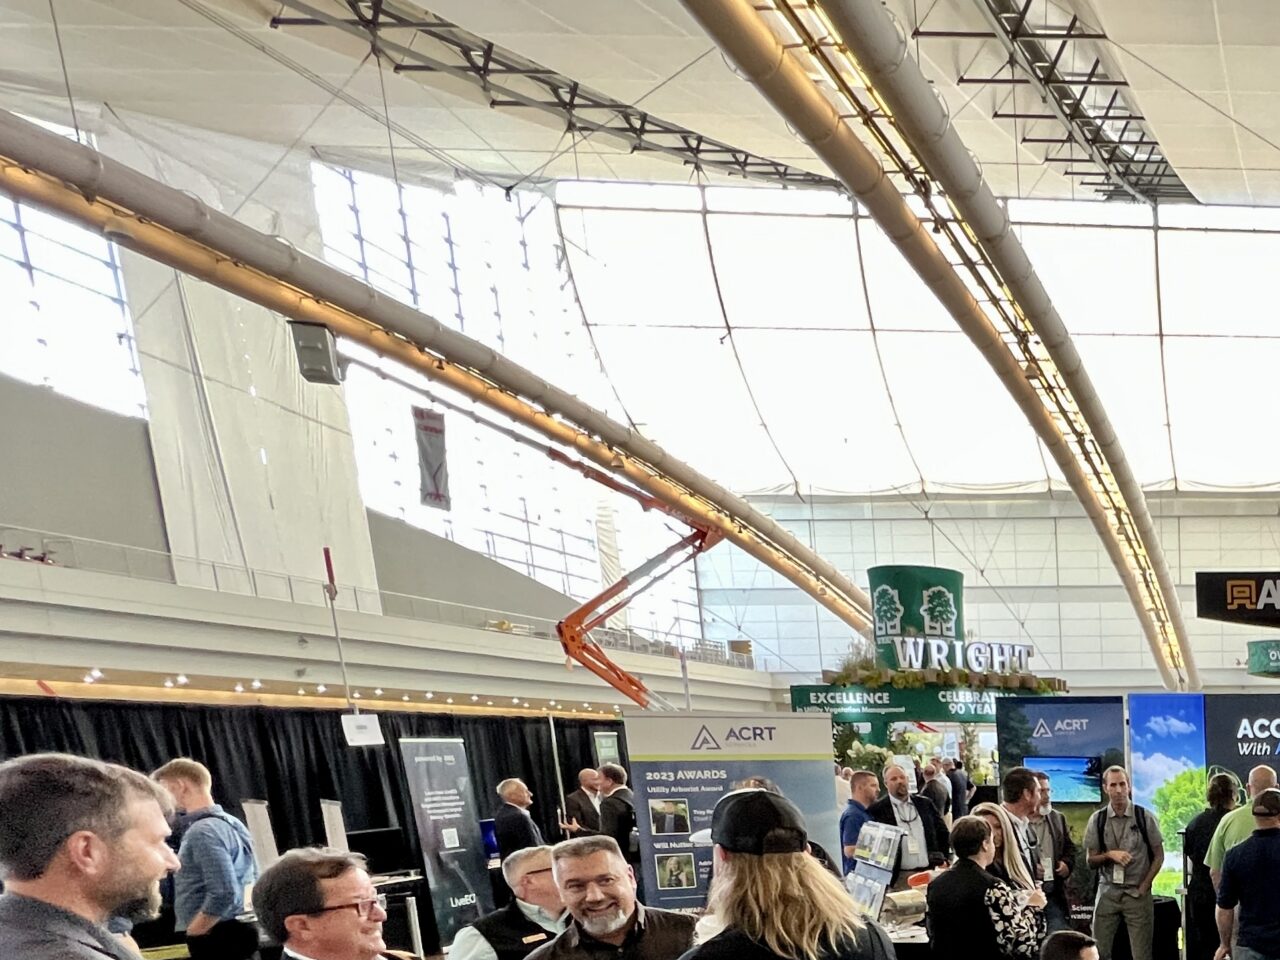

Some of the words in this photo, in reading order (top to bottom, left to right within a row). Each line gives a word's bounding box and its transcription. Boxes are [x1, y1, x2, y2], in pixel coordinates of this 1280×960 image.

[893, 637, 1034, 675] WRIGHT
[809, 692, 890, 704] EXCELLENCE
[949, 703, 966, 715] 90
[1054, 719, 1089, 731] ACRT
[724, 726, 777, 741] ACRT
[1238, 742, 1270, 756] With
[645, 772, 676, 781] 2023
[676, 770, 727, 780] AWARDS
